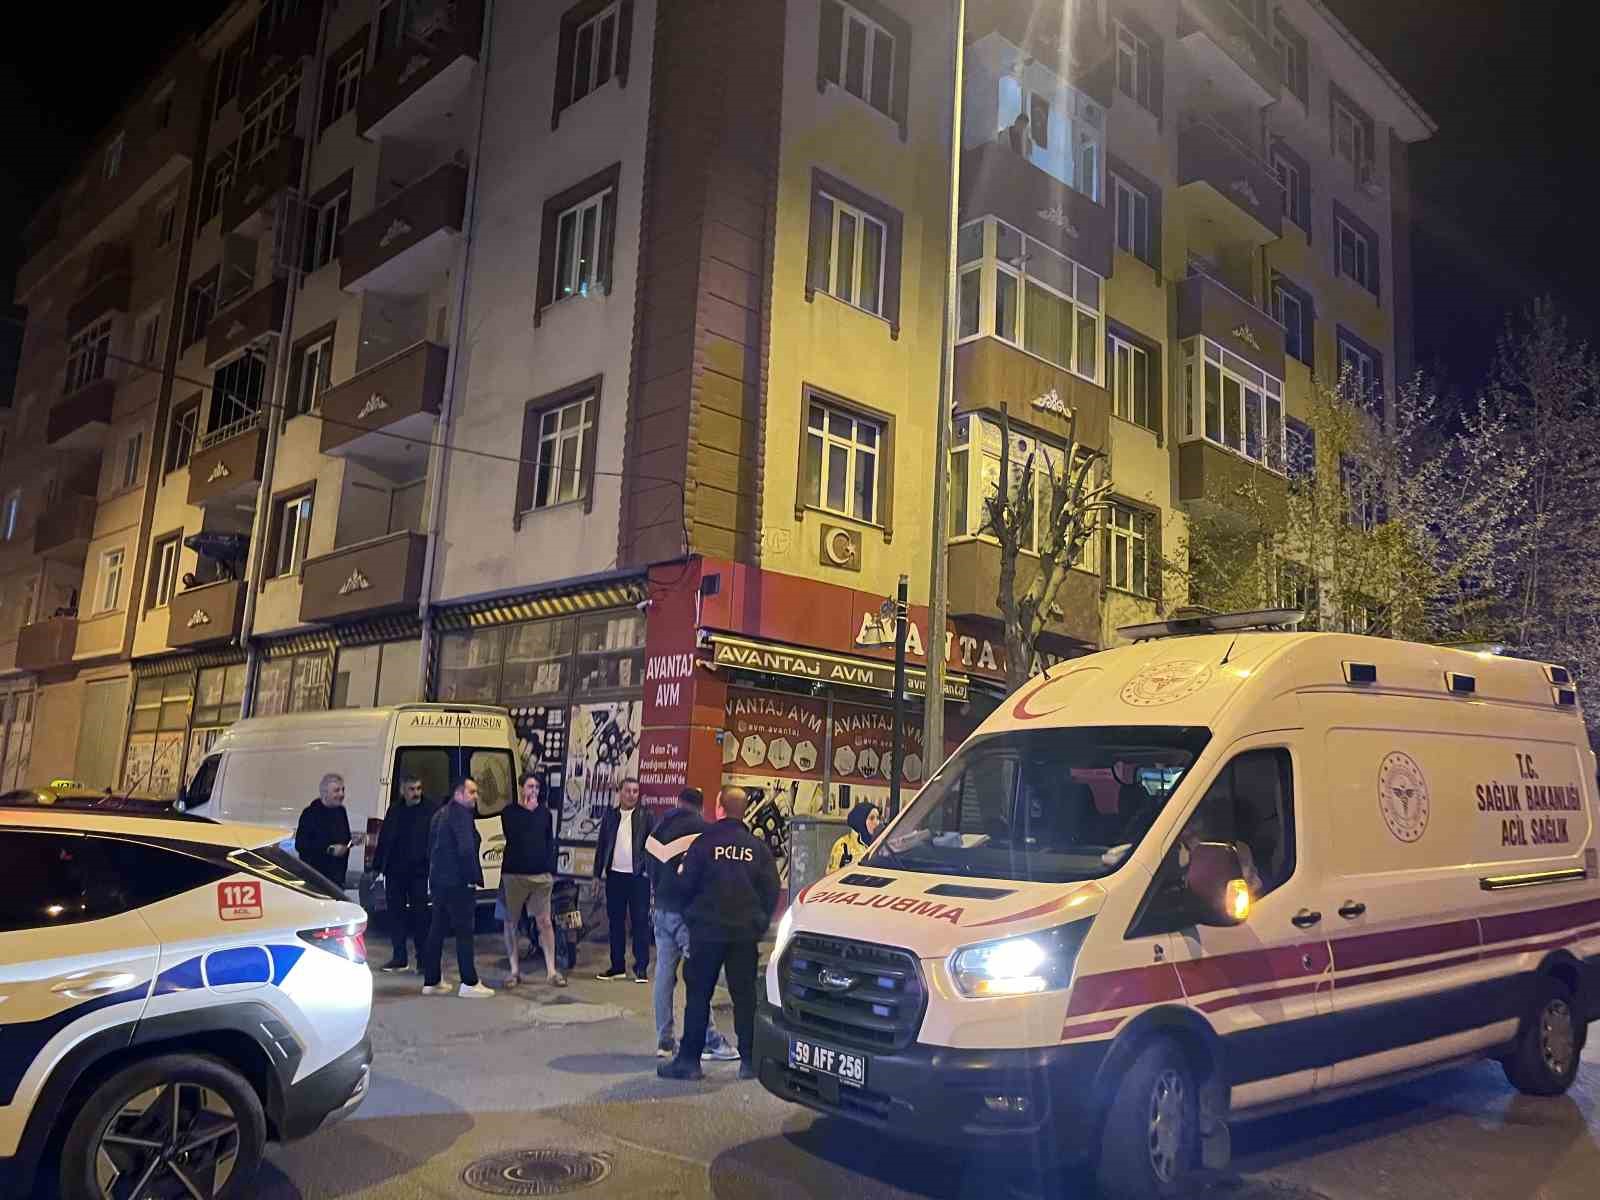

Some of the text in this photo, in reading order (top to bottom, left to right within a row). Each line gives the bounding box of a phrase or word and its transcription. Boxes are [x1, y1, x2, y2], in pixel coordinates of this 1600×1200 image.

[646, 653, 694, 706] AVANTAJ AVM
[830, 664, 874, 684] AVM
[454, 714, 502, 729] KORUSUN
[725, 697, 822, 733] VANTAJ AVM
[834, 713, 893, 736] AVANTAJ
[1515, 753, 1539, 779] T.C.
[1476, 780, 1521, 811] SAĞLIK
[1530, 815, 1568, 844] SAĞLIK
[224, 886, 256, 905] 112
[795, 1041, 862, 1080] 59 AFF 256
